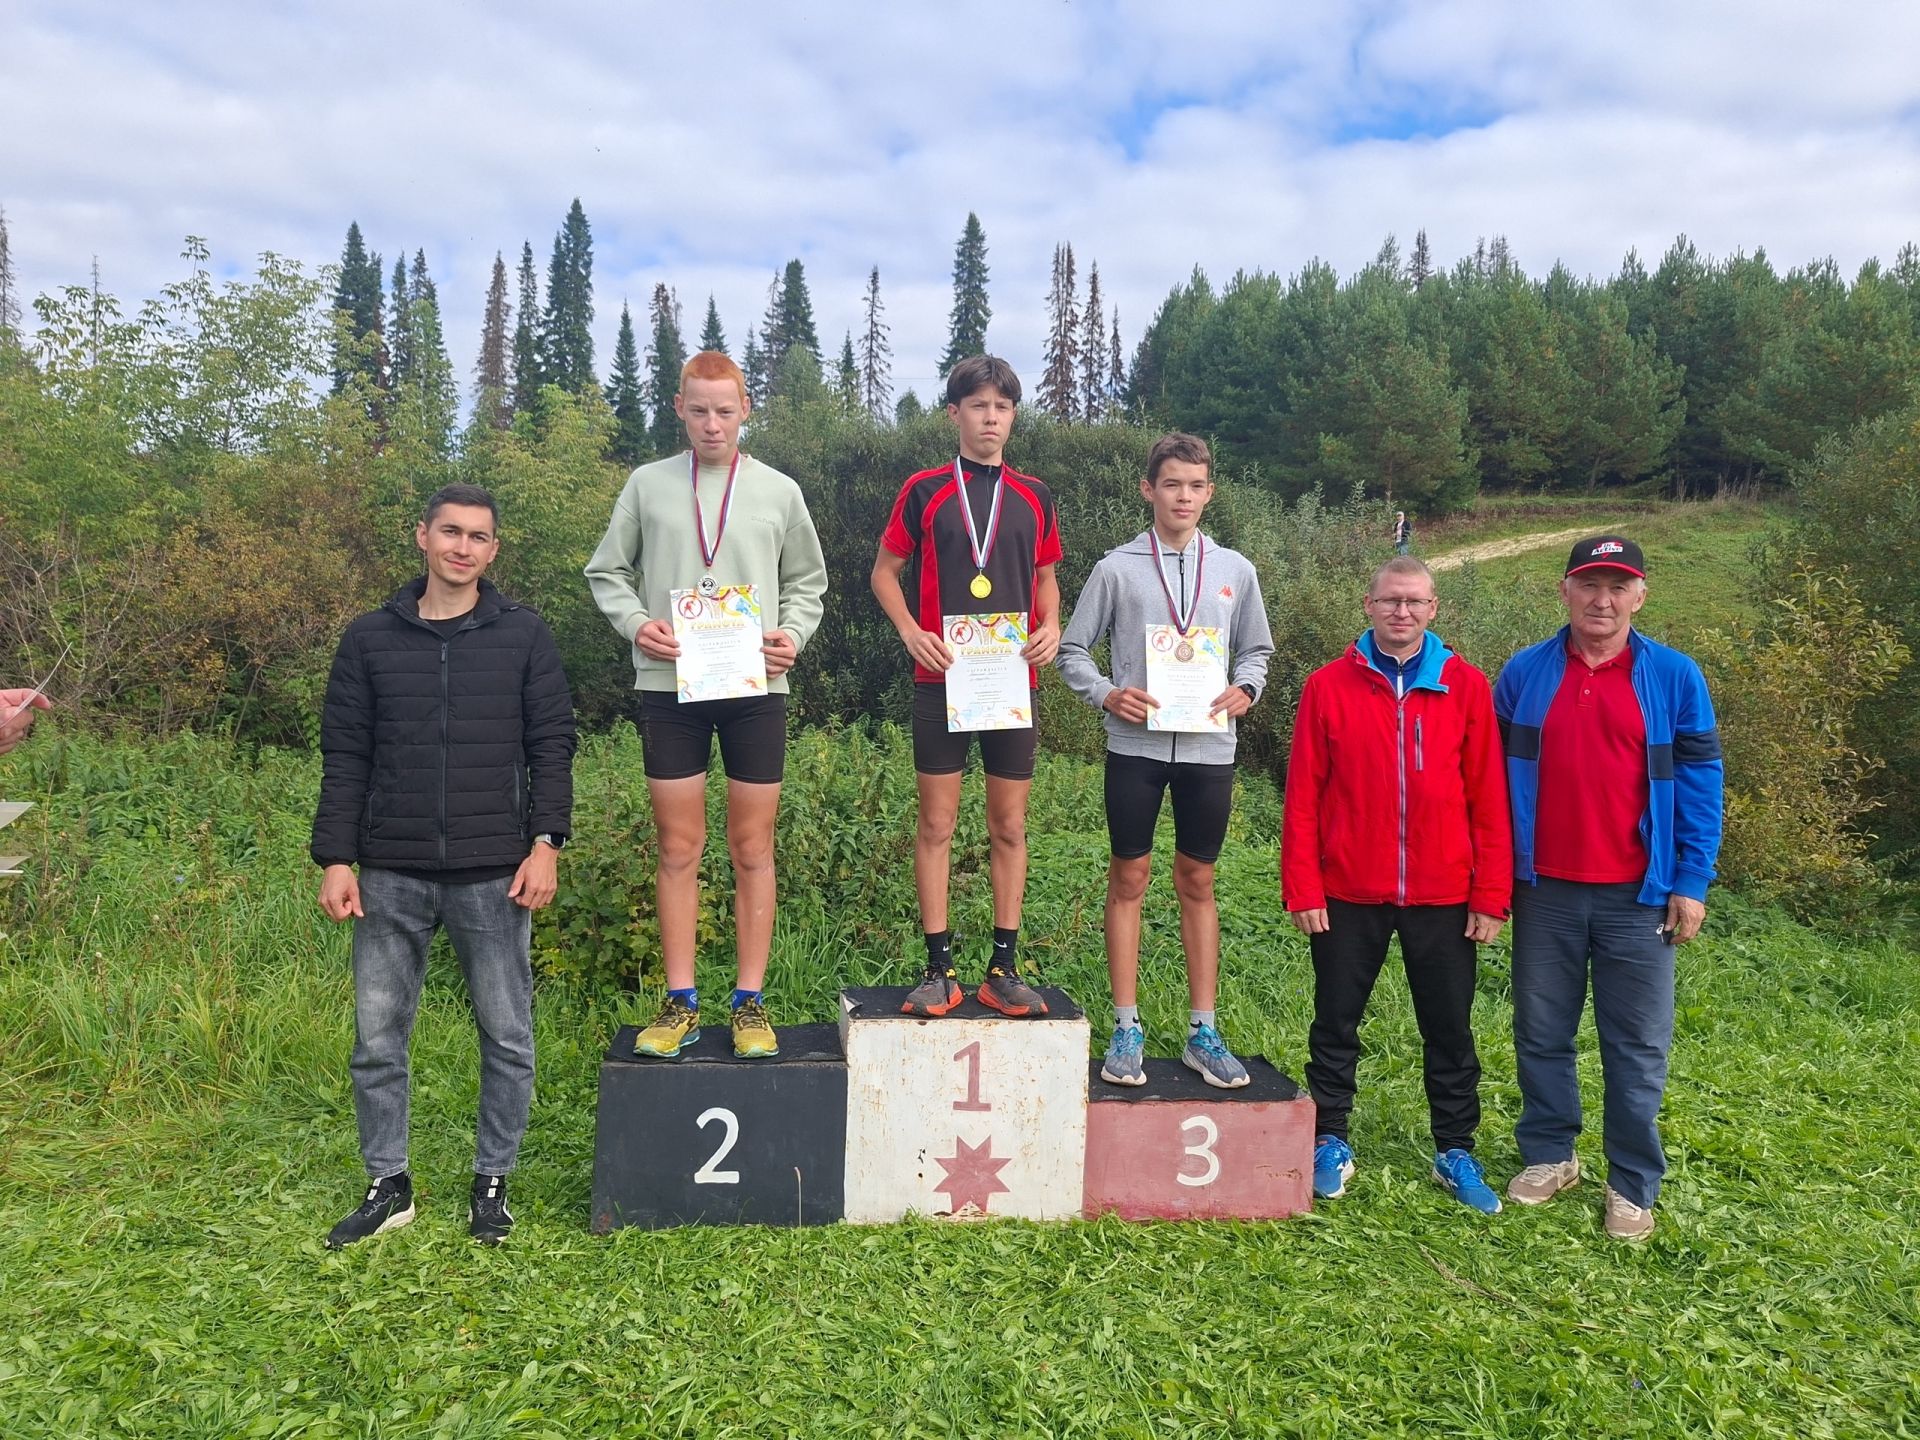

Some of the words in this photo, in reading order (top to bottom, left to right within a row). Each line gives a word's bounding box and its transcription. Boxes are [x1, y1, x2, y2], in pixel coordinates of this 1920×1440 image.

[952, 1041, 992, 1112] 1
[694, 1107, 740, 1185] 2
[1176, 1116, 1221, 1187] 3
